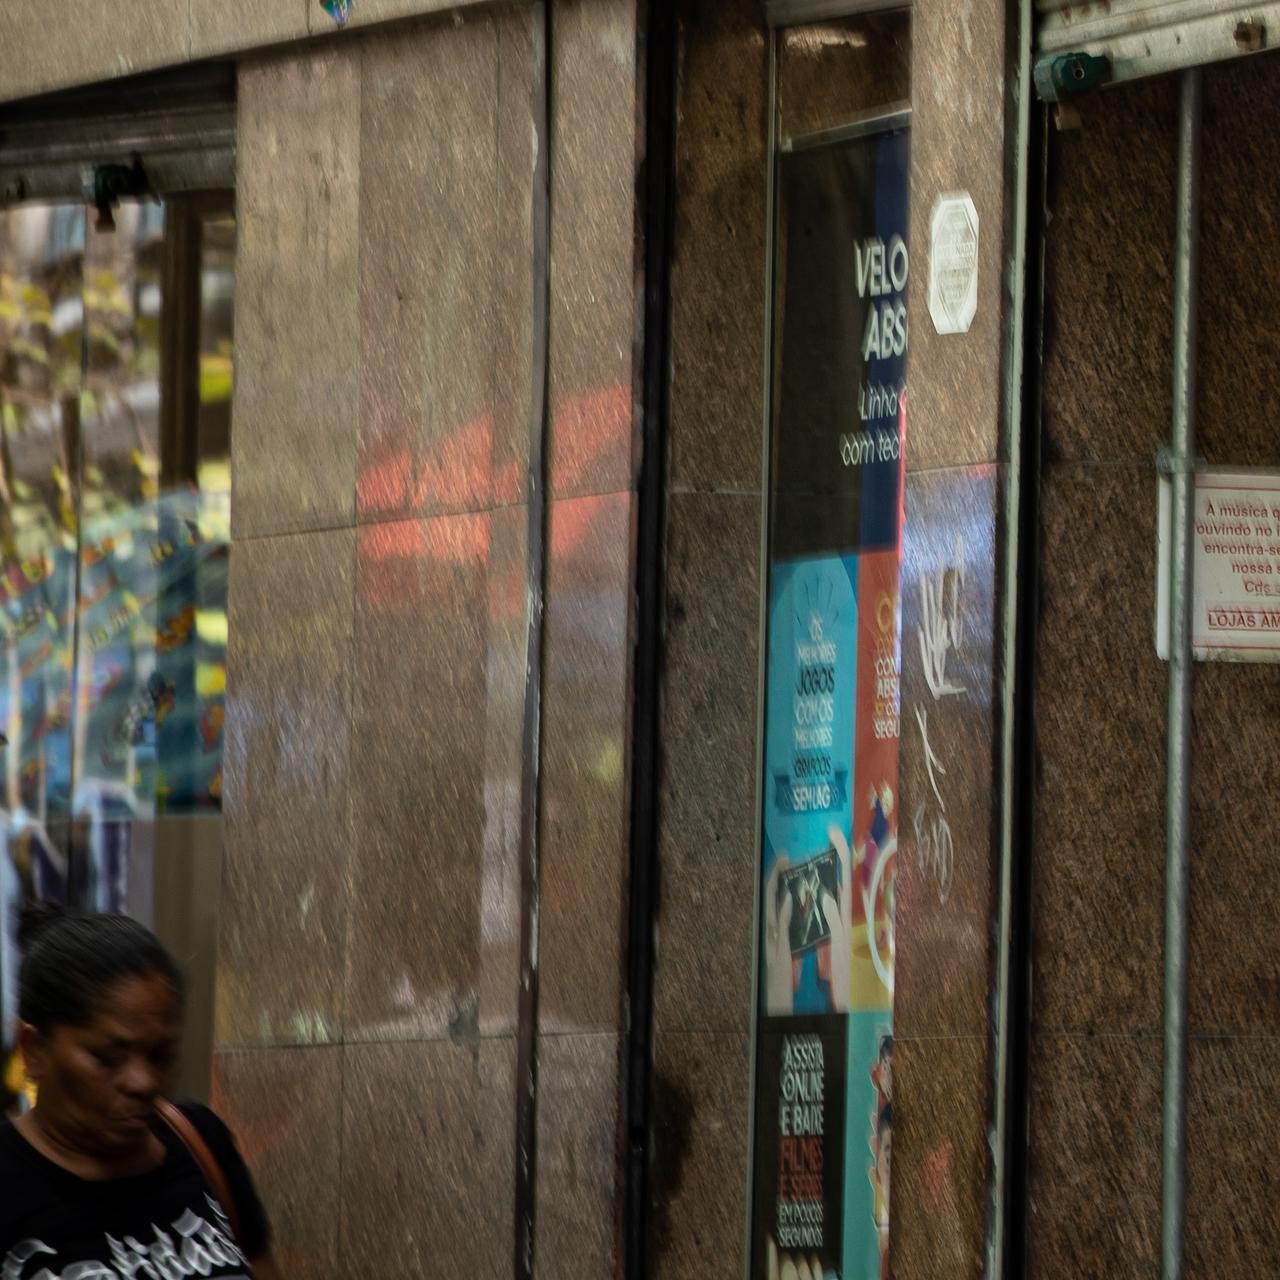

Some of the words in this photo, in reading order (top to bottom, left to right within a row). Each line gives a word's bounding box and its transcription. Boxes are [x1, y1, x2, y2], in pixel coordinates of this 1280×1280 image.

[863, 300, 908, 361] ABS
[1197, 522, 1250, 536] ouvindo
[1255, 524, 1272, 536] no
[1232, 561, 1272, 574] nossa
[1208, 612, 1256, 628] LOJAS
[797, 667, 835, 697] JOGOS
